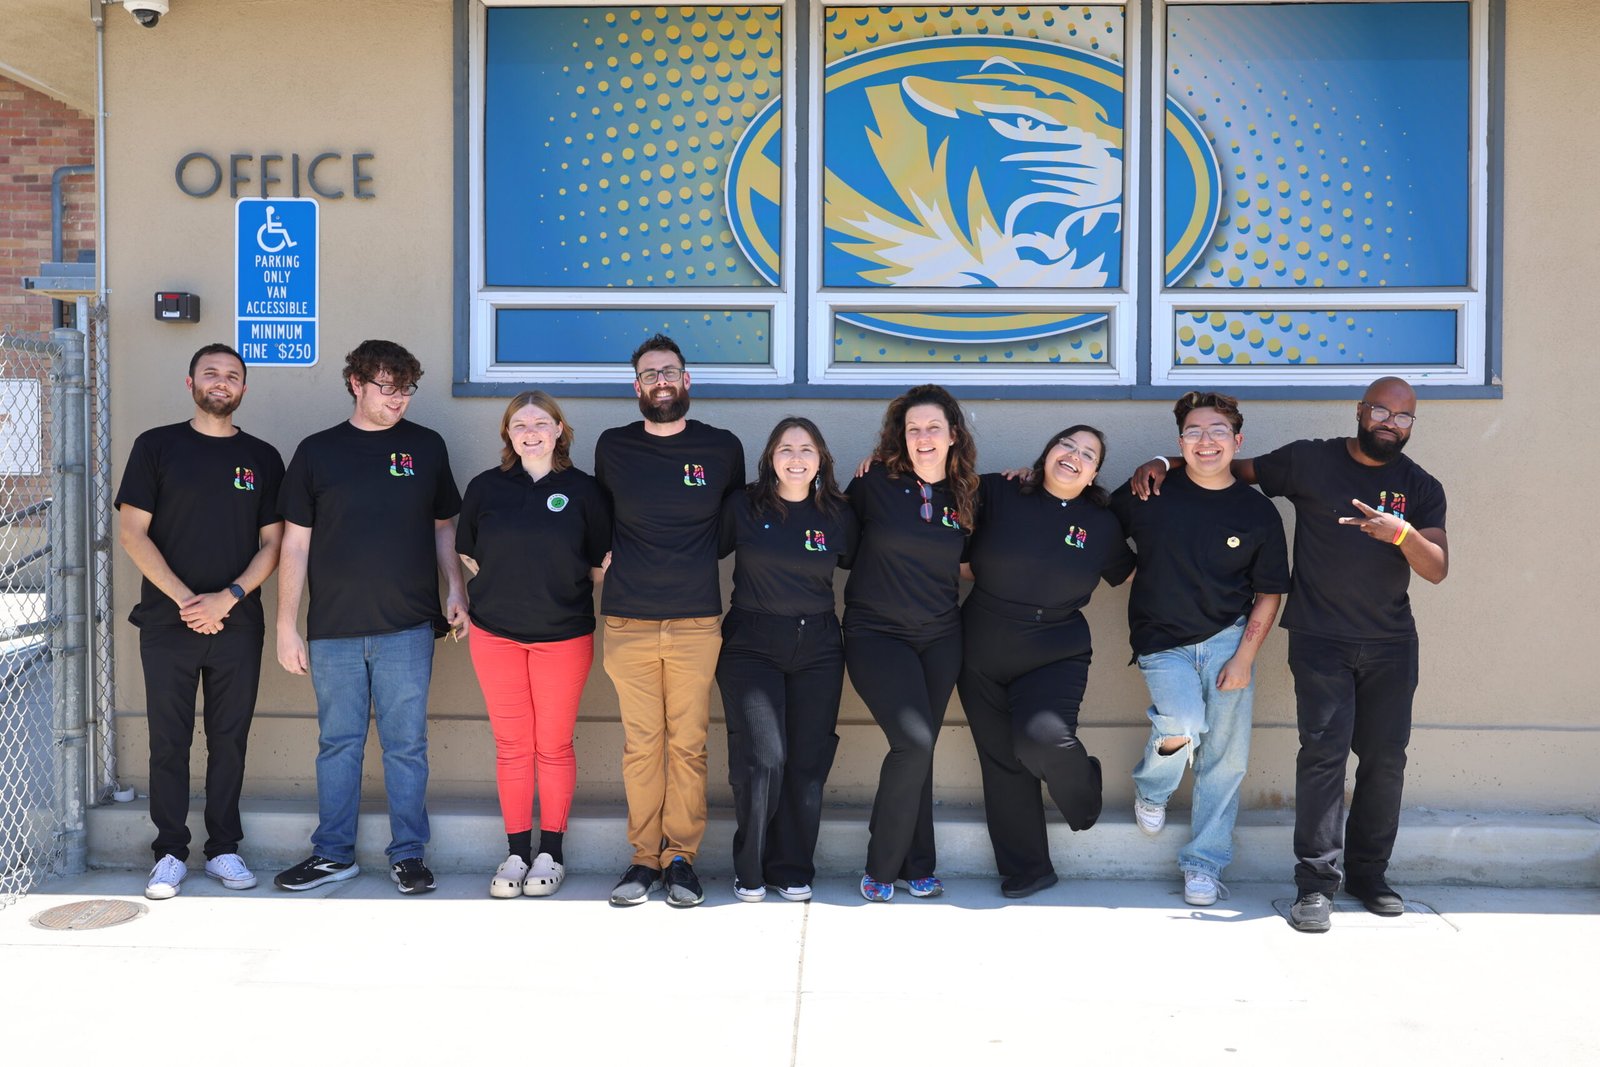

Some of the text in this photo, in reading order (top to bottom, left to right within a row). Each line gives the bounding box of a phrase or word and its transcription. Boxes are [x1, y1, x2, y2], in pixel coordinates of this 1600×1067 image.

[175, 152, 375, 199] OFFICE
[255, 255, 300, 268] PARKING
[264, 271, 291, 283] ONLY
[267, 286, 287, 299] VAN
[246, 302, 308, 315] ACCESSIBLE
[252, 324, 303, 340] MINIMUM
[243, 342, 311, 360] FINE $250
